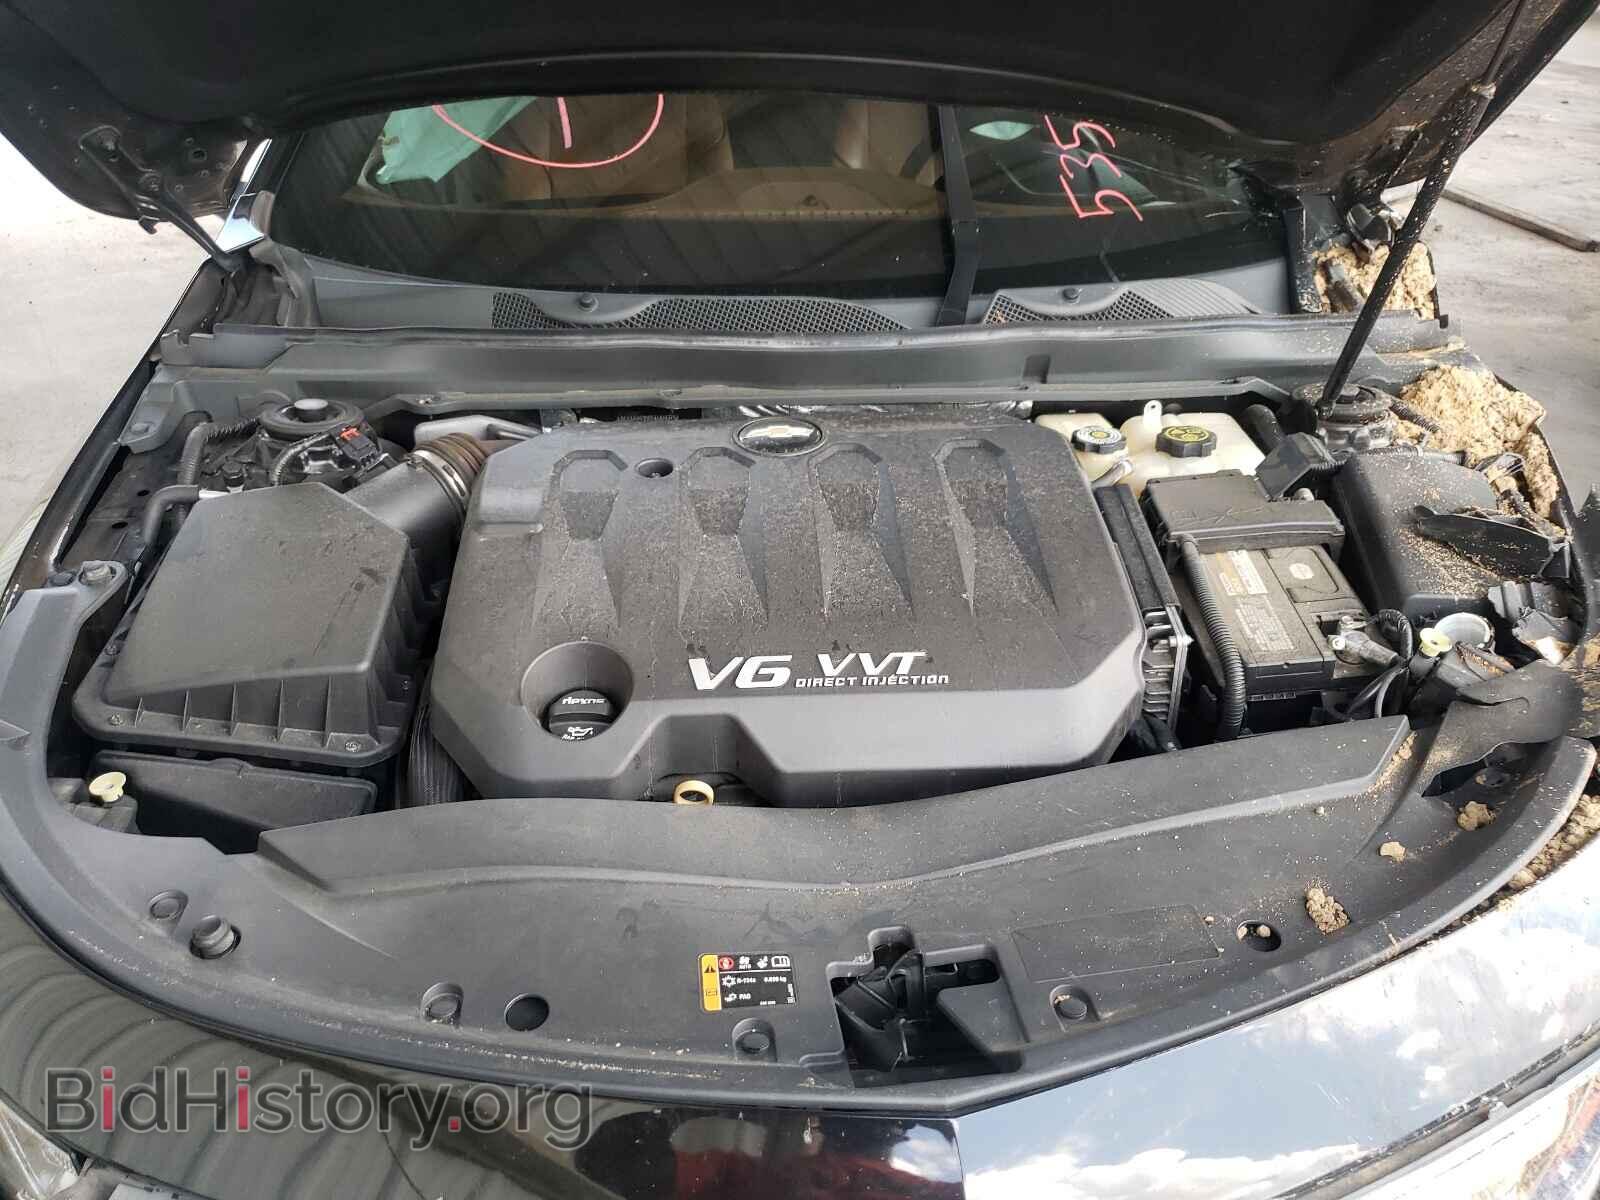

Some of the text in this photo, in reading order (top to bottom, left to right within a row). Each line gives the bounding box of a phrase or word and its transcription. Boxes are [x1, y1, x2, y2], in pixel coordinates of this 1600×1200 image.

[1044, 114, 1143, 222] 535
[688, 651, 927, 691] V6 VVT
[795, 677, 858, 688] DIRECT
